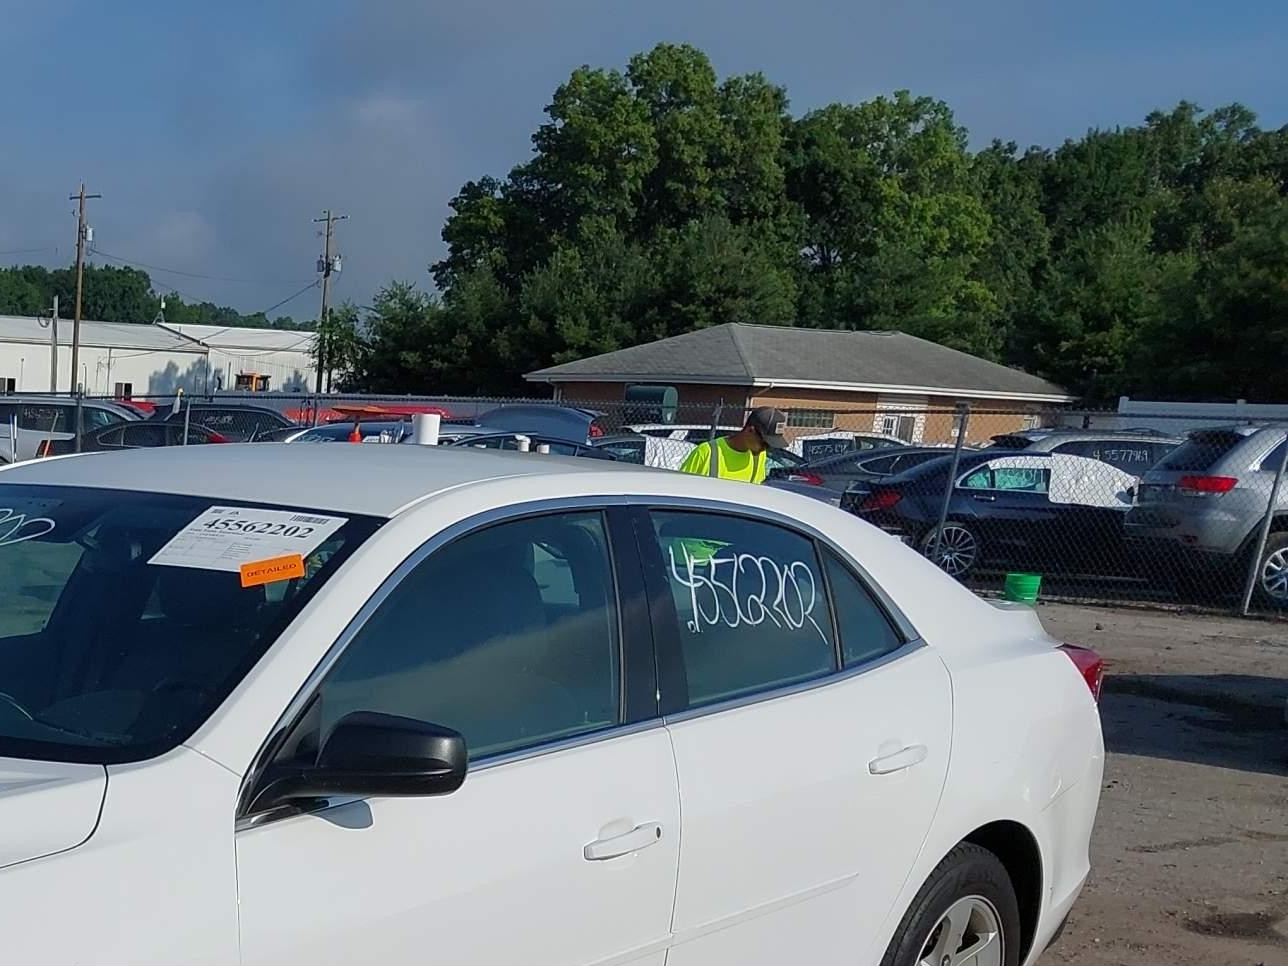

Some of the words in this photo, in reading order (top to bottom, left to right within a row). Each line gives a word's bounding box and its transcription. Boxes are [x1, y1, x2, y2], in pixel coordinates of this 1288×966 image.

[203, 518, 315, 539] 45562202
[246, 563, 297, 578] DETAILED
[668, 541, 829, 646] 45562202
